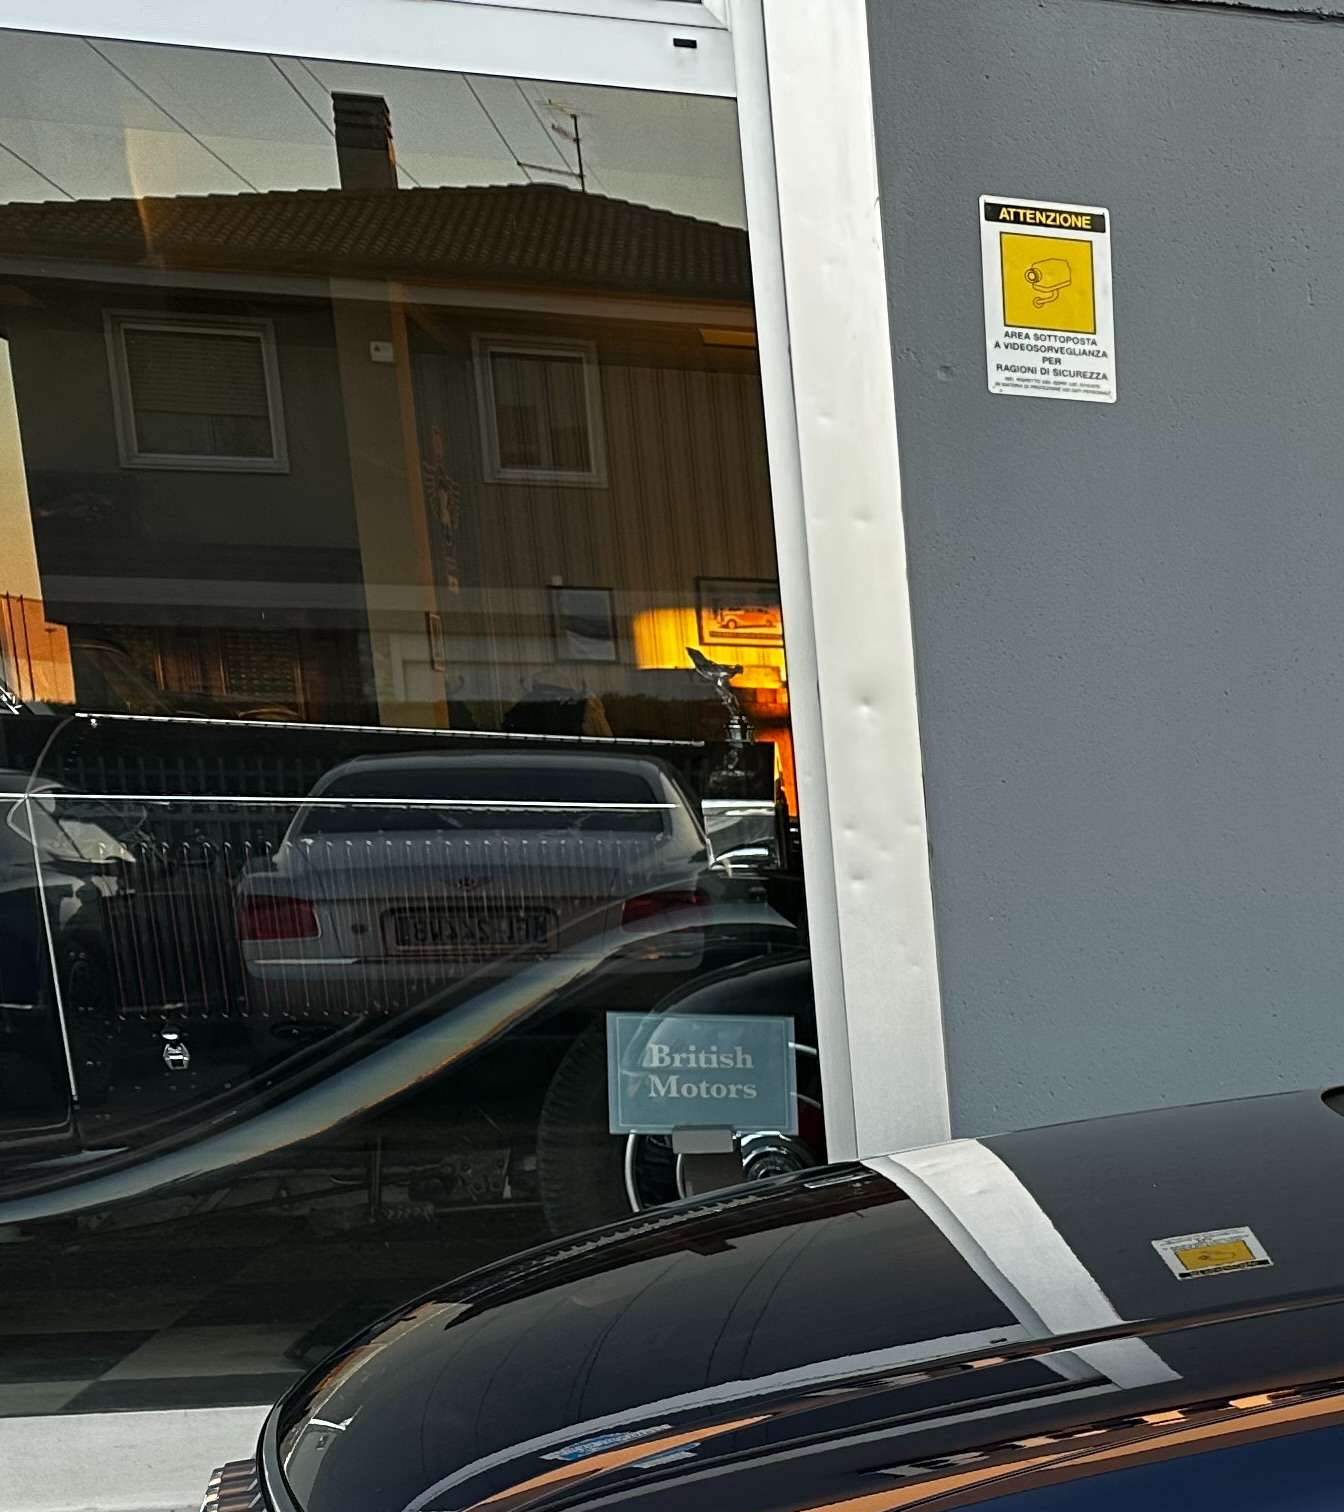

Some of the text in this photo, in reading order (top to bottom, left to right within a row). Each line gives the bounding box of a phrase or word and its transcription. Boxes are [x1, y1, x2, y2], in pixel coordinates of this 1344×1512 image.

[999, 207, 1092, 229] ATTENZIONE
[1004, 331, 1098, 346] AREA SOTTOPOSTA
[994, 341, 1109, 359] A VIDEOSORVEGLIANZA
[1042, 356, 1062, 366] PER
[996, 363, 1109, 381] RAGIONI DI SICUREZZA
[650, 1044, 754, 1069] British
[649, 1074, 758, 1099] Motors
